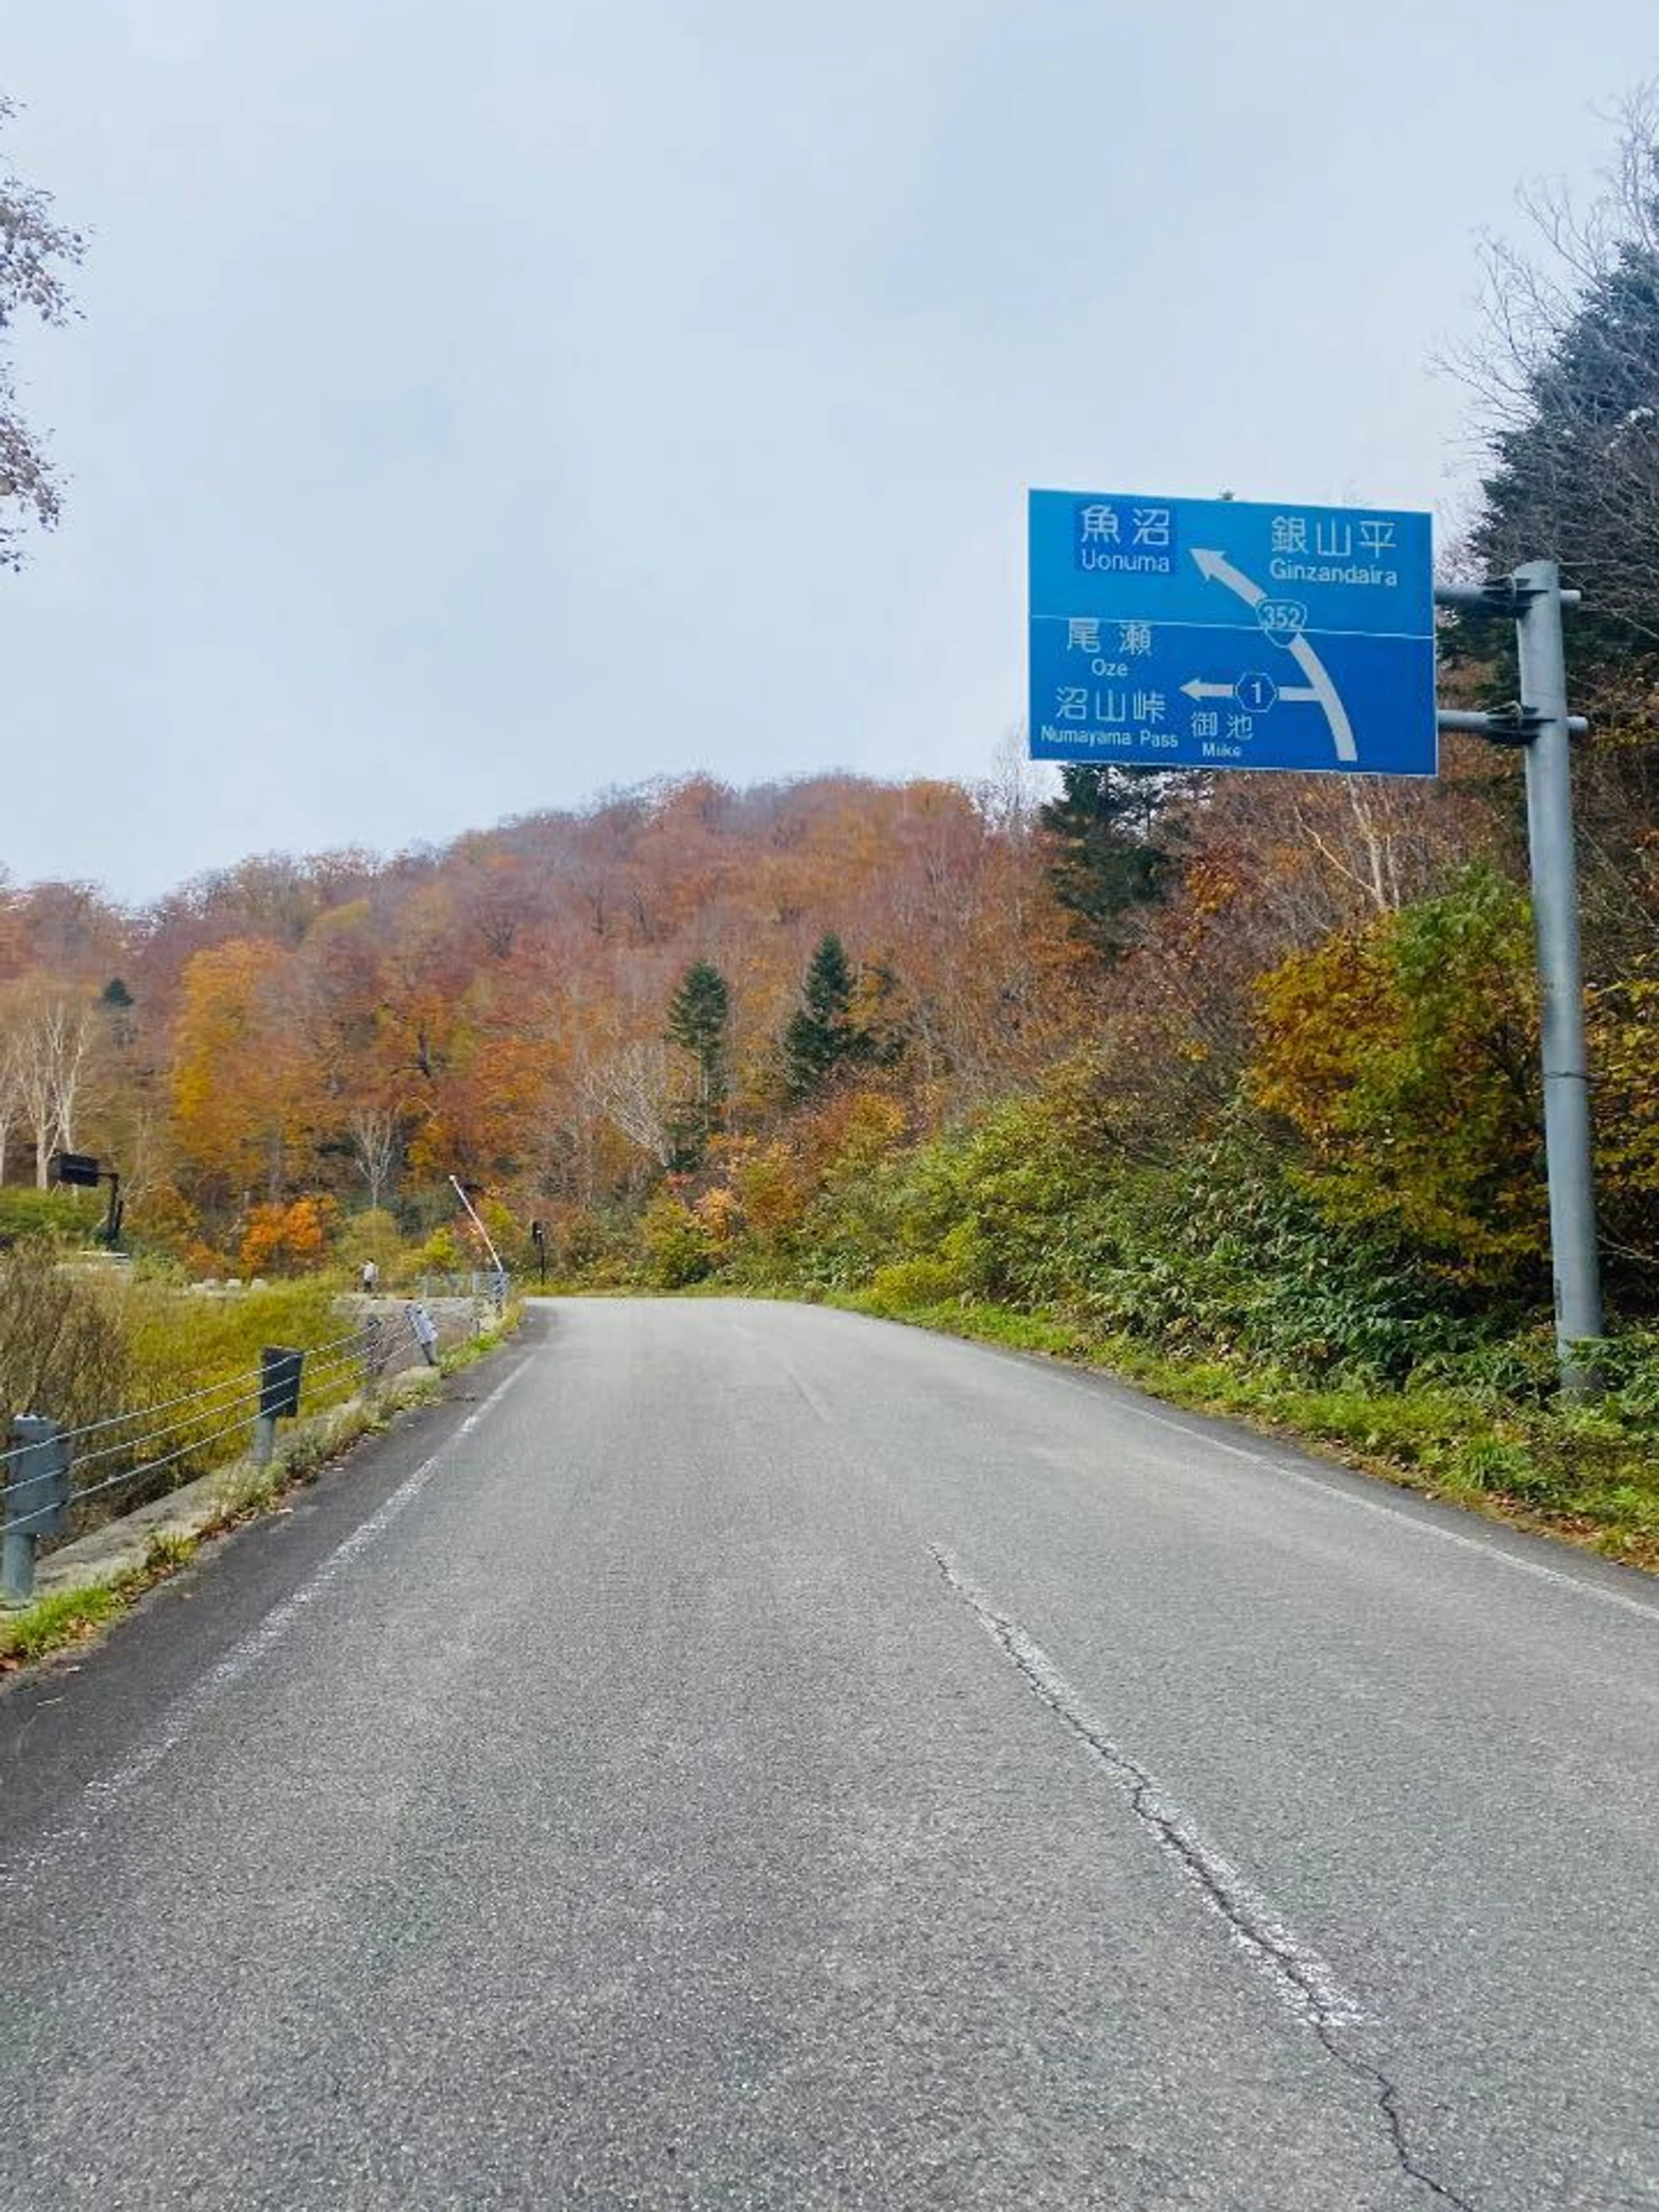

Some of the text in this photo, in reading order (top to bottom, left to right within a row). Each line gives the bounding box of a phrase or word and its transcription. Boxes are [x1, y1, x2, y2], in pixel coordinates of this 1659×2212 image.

[1081, 504, 1169, 545] 魚沼
[1271, 516, 1397, 558] 銀山平
[1082, 548, 1169, 572] Uonuma
[1269, 557, 1398, 587] Ginzandaira
[1262, 605, 1301, 628] 352
[1091, 658, 1128, 677] Oze
[1055, 686, 1166, 722] 沼山峠
[1251, 682, 1261, 704] 1
[1041, 725, 1179, 748] Numayama Pass
[1191, 711, 1254, 741] 御池
